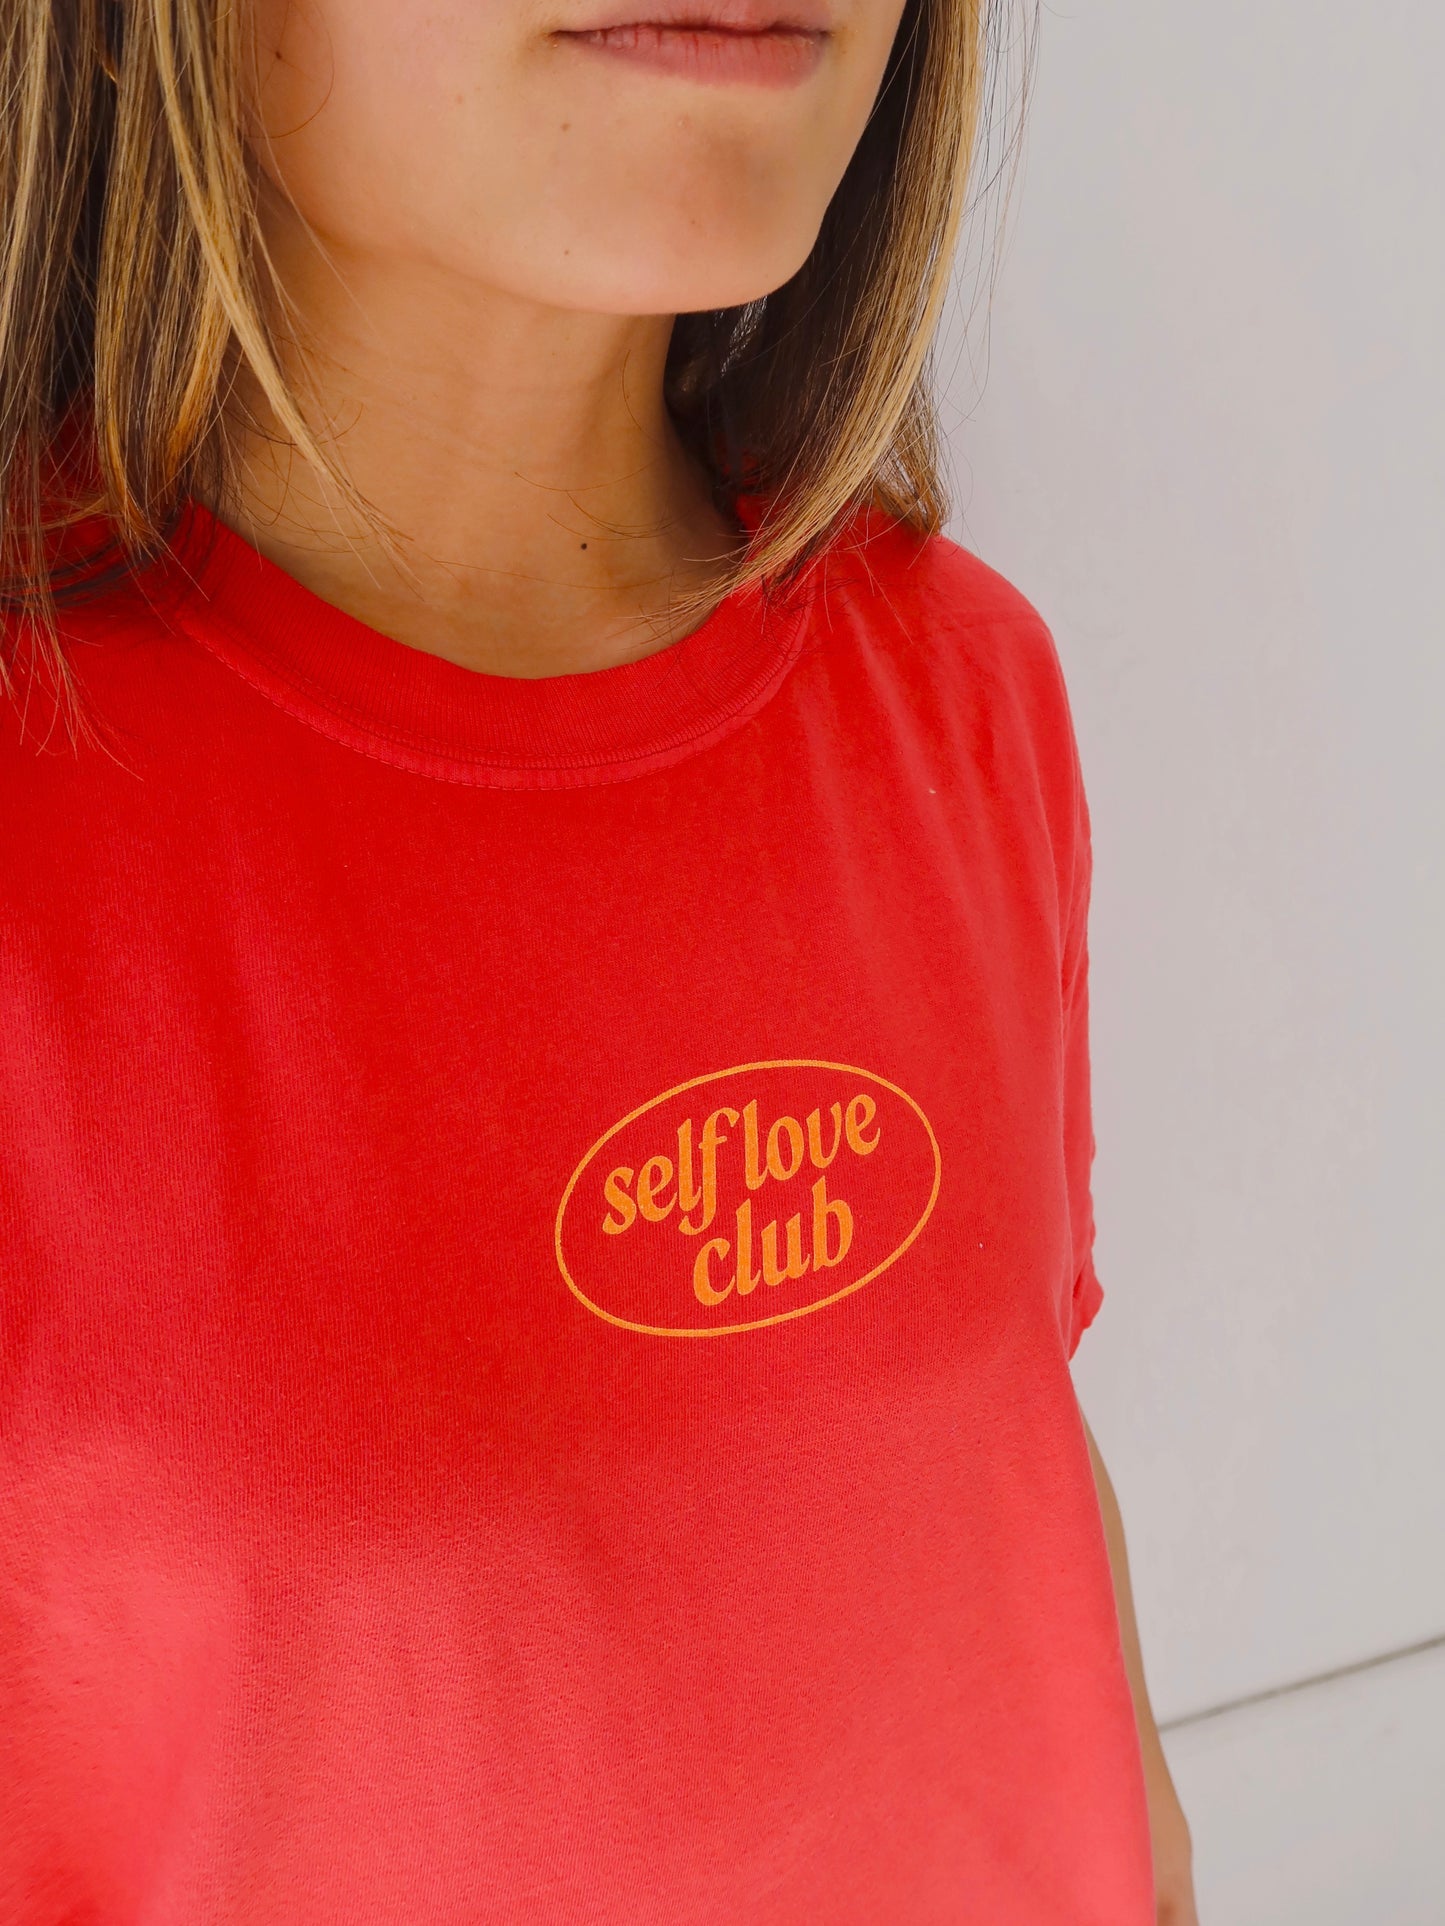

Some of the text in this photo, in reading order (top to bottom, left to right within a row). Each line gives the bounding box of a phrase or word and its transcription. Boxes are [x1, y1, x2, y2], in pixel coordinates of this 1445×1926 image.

[602, 1094, 881, 1235] self love
[693, 1176, 854, 1307] club
